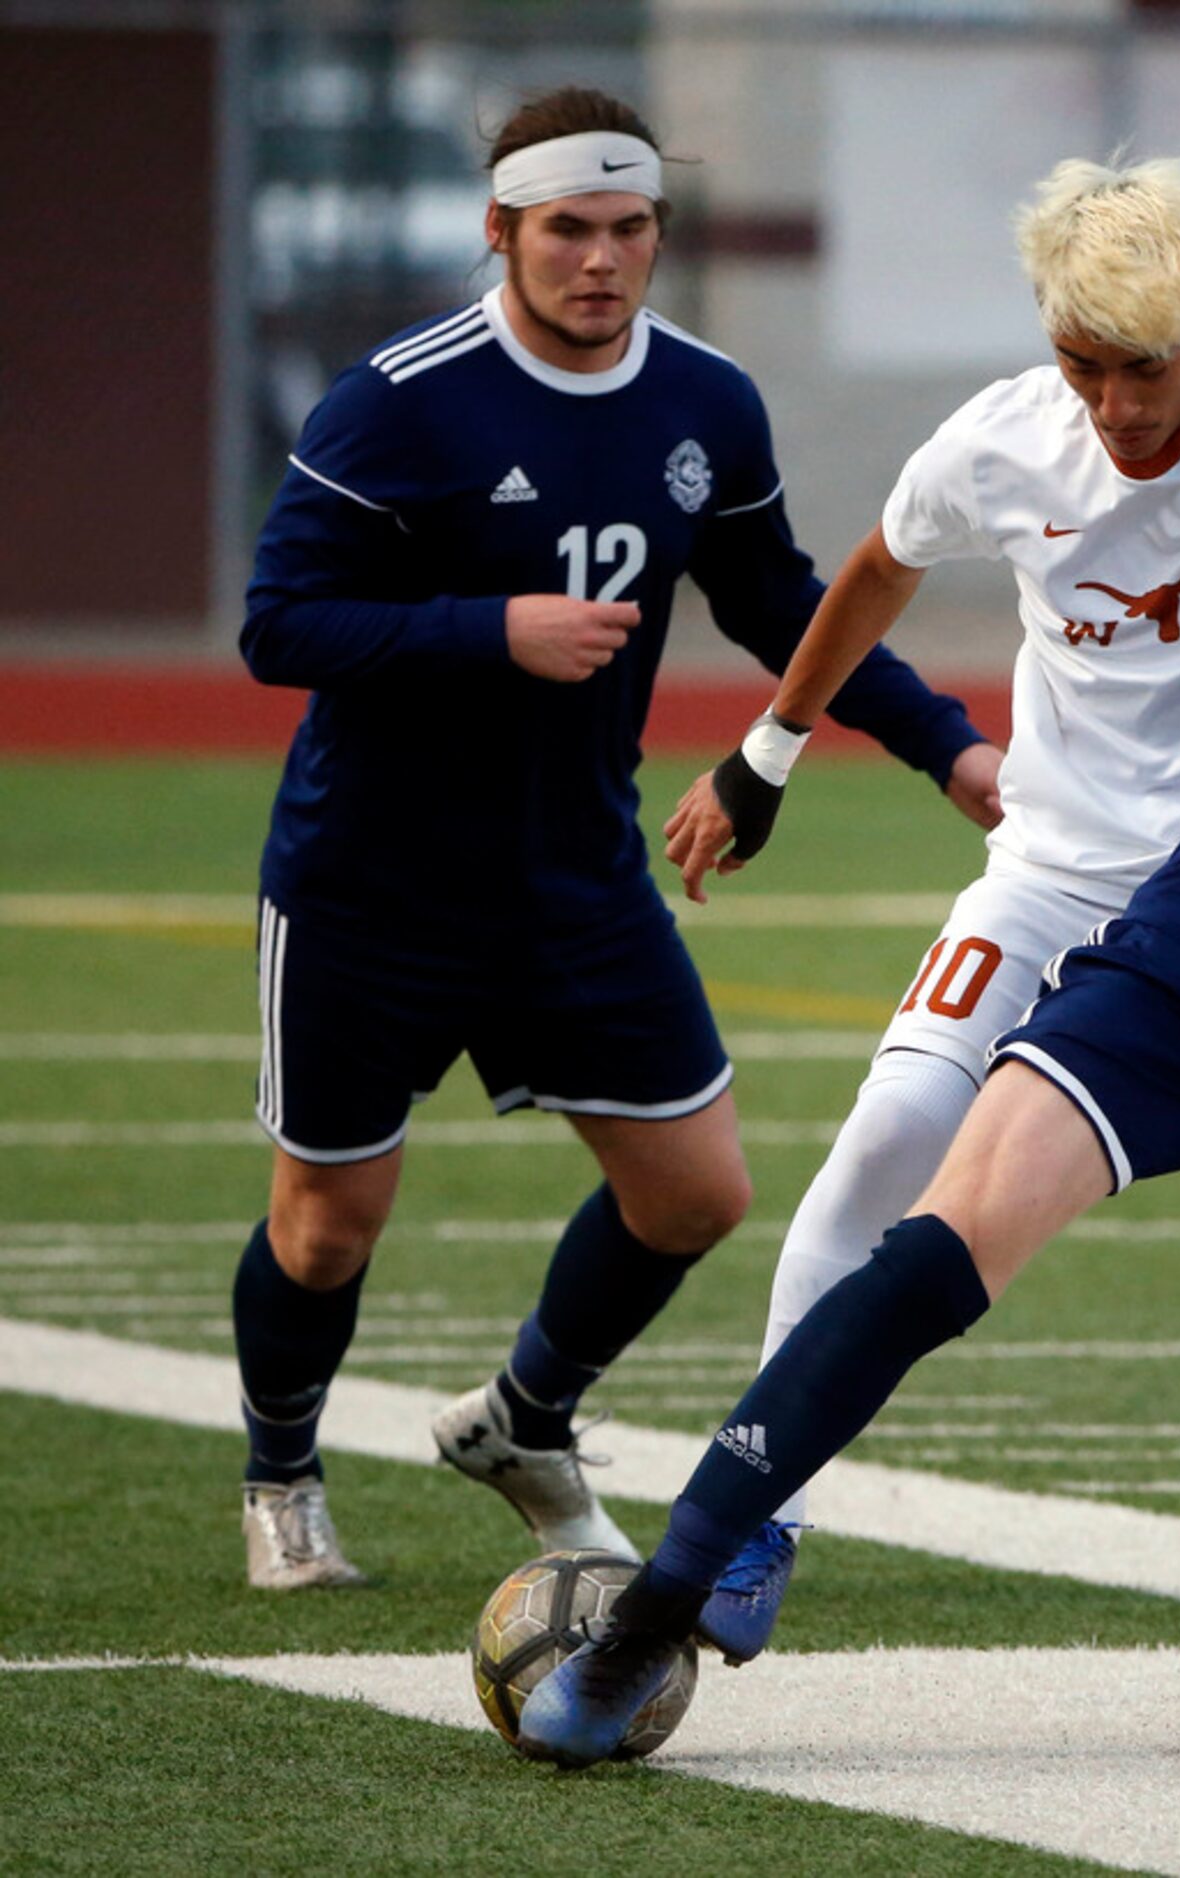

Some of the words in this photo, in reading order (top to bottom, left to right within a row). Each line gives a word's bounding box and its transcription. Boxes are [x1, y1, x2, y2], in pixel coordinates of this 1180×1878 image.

[557, 522, 647, 605] 12
[1064, 617, 1118, 646] W
[716, 1430, 773, 1474] adidas
